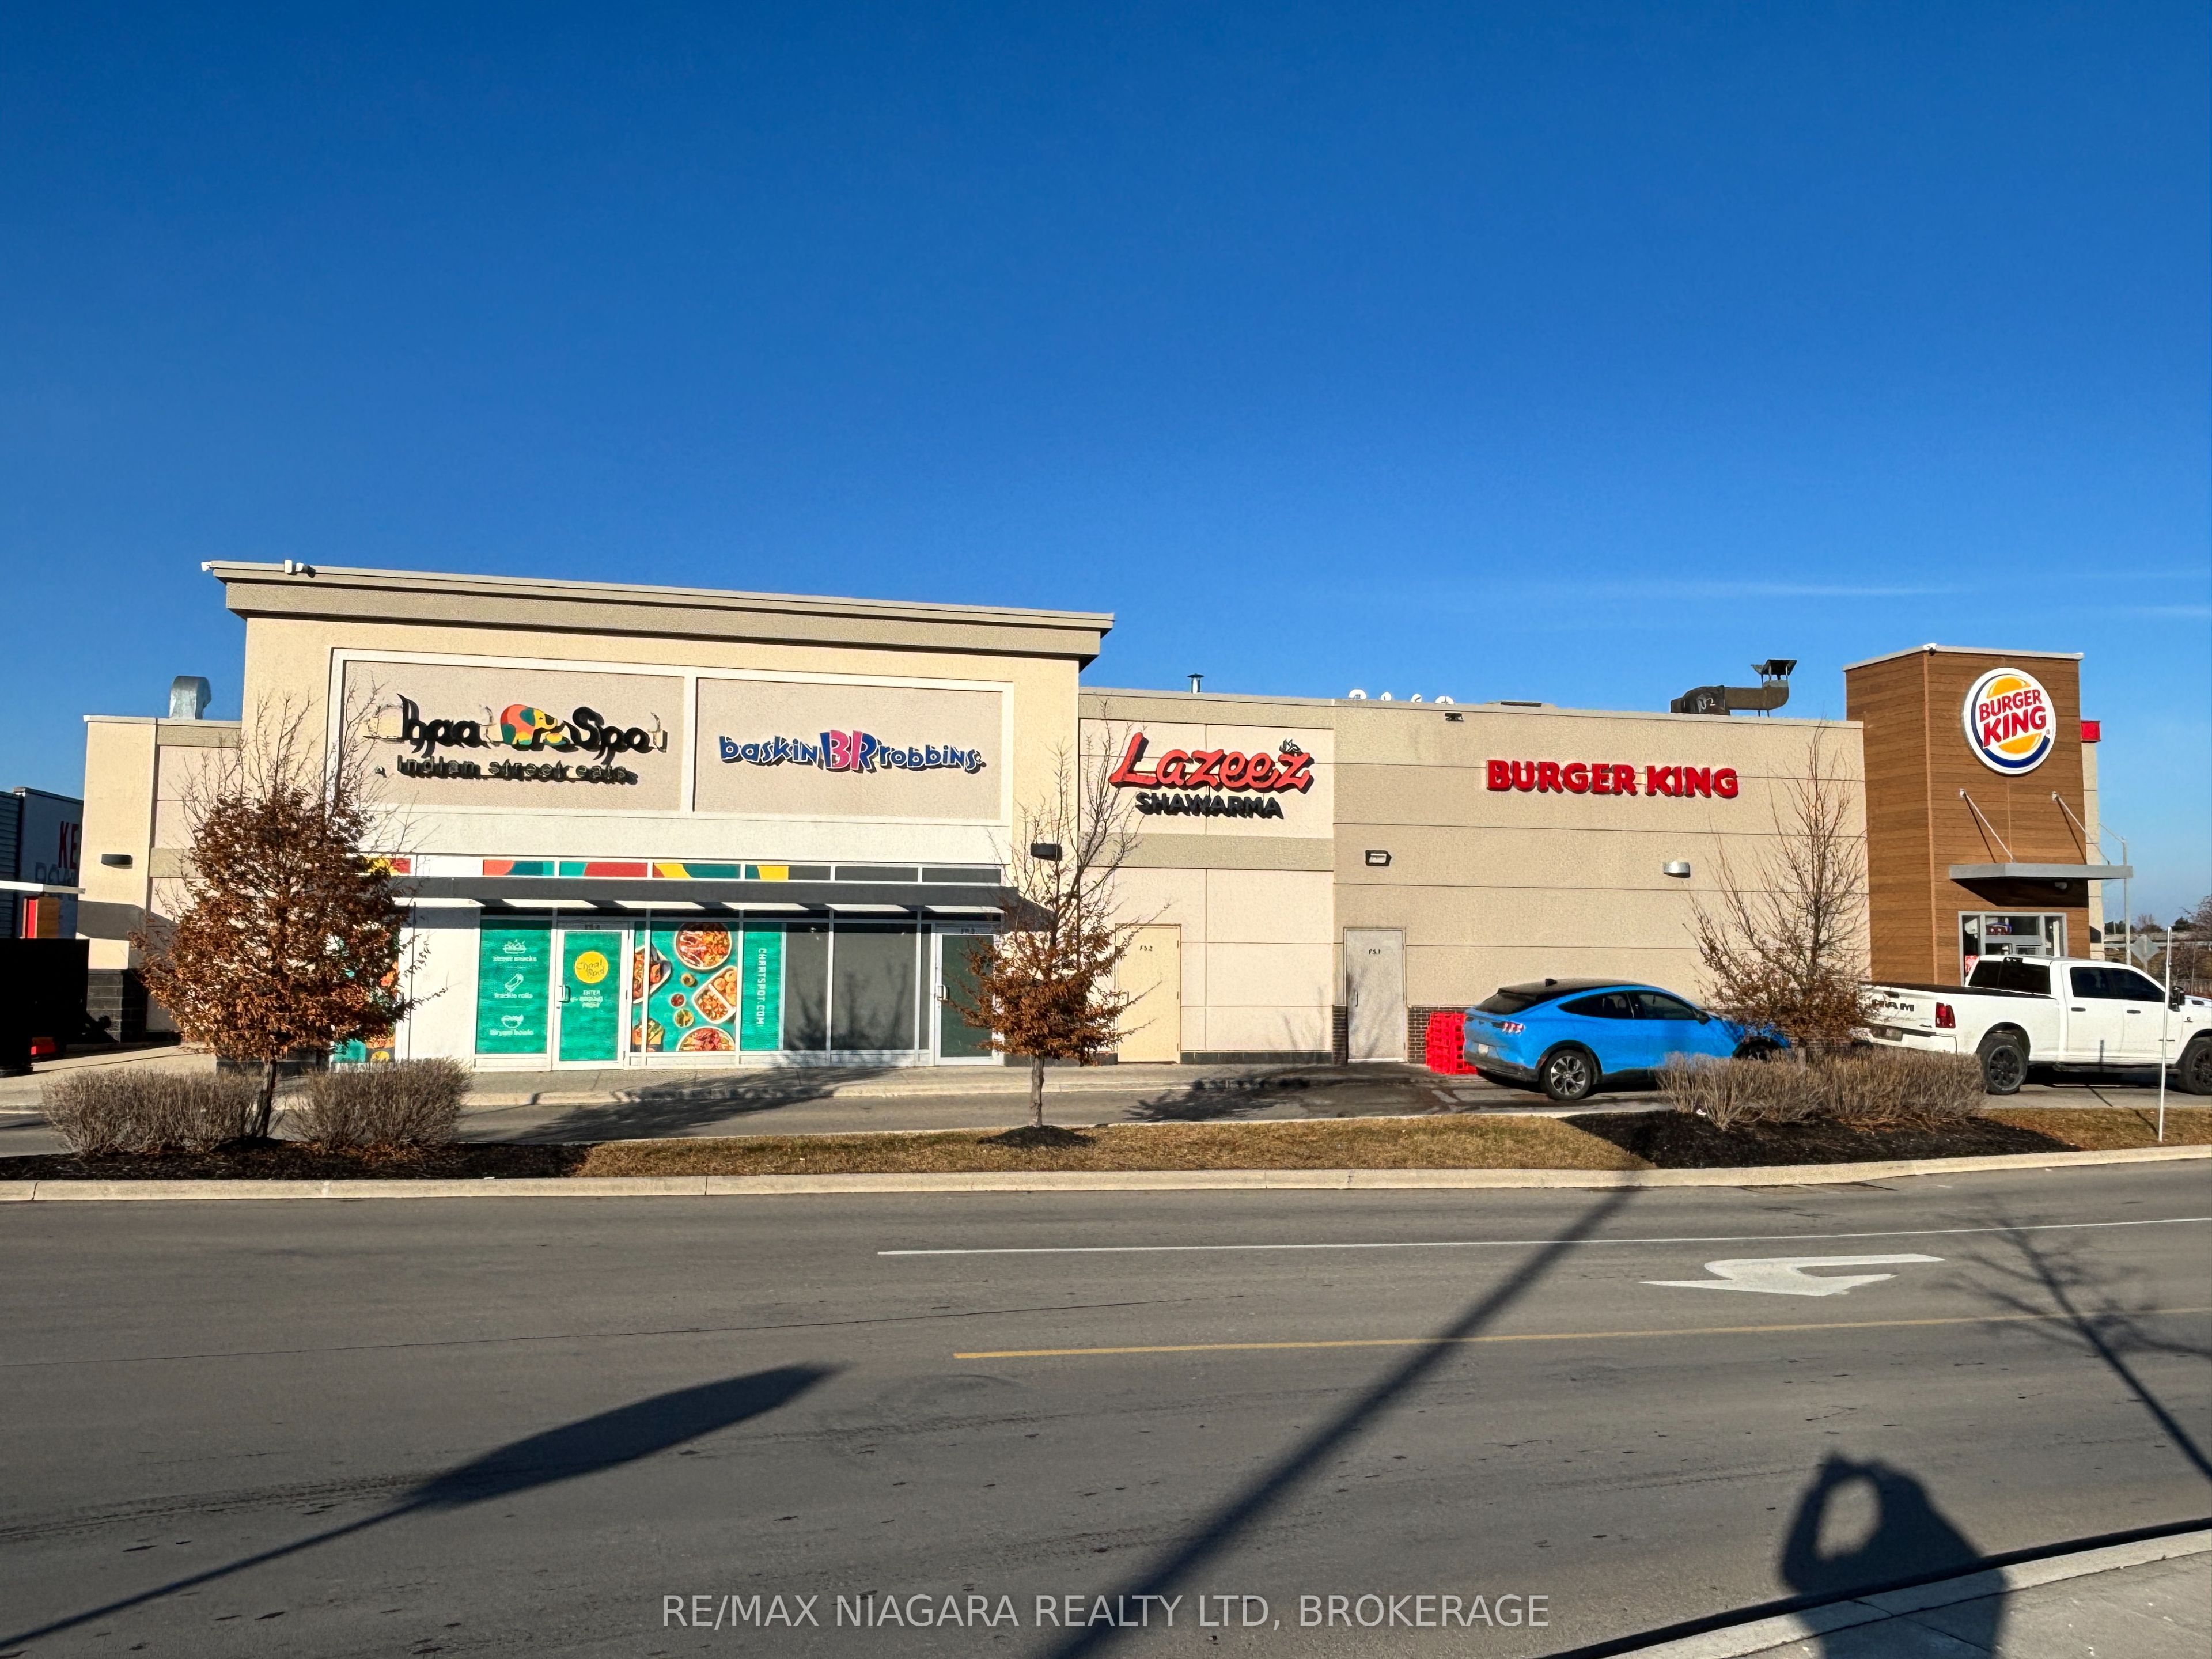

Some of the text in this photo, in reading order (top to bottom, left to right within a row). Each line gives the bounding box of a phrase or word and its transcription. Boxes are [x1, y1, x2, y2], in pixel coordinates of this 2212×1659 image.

[1979, 689, 2043, 722] BURGER
[1983, 706, 2047, 748] KING
[719, 729, 982, 773] baskin BR robbins
[1486, 759, 1740, 799] BURGER KING
[1135, 791, 1284, 819] SHAWARMA
